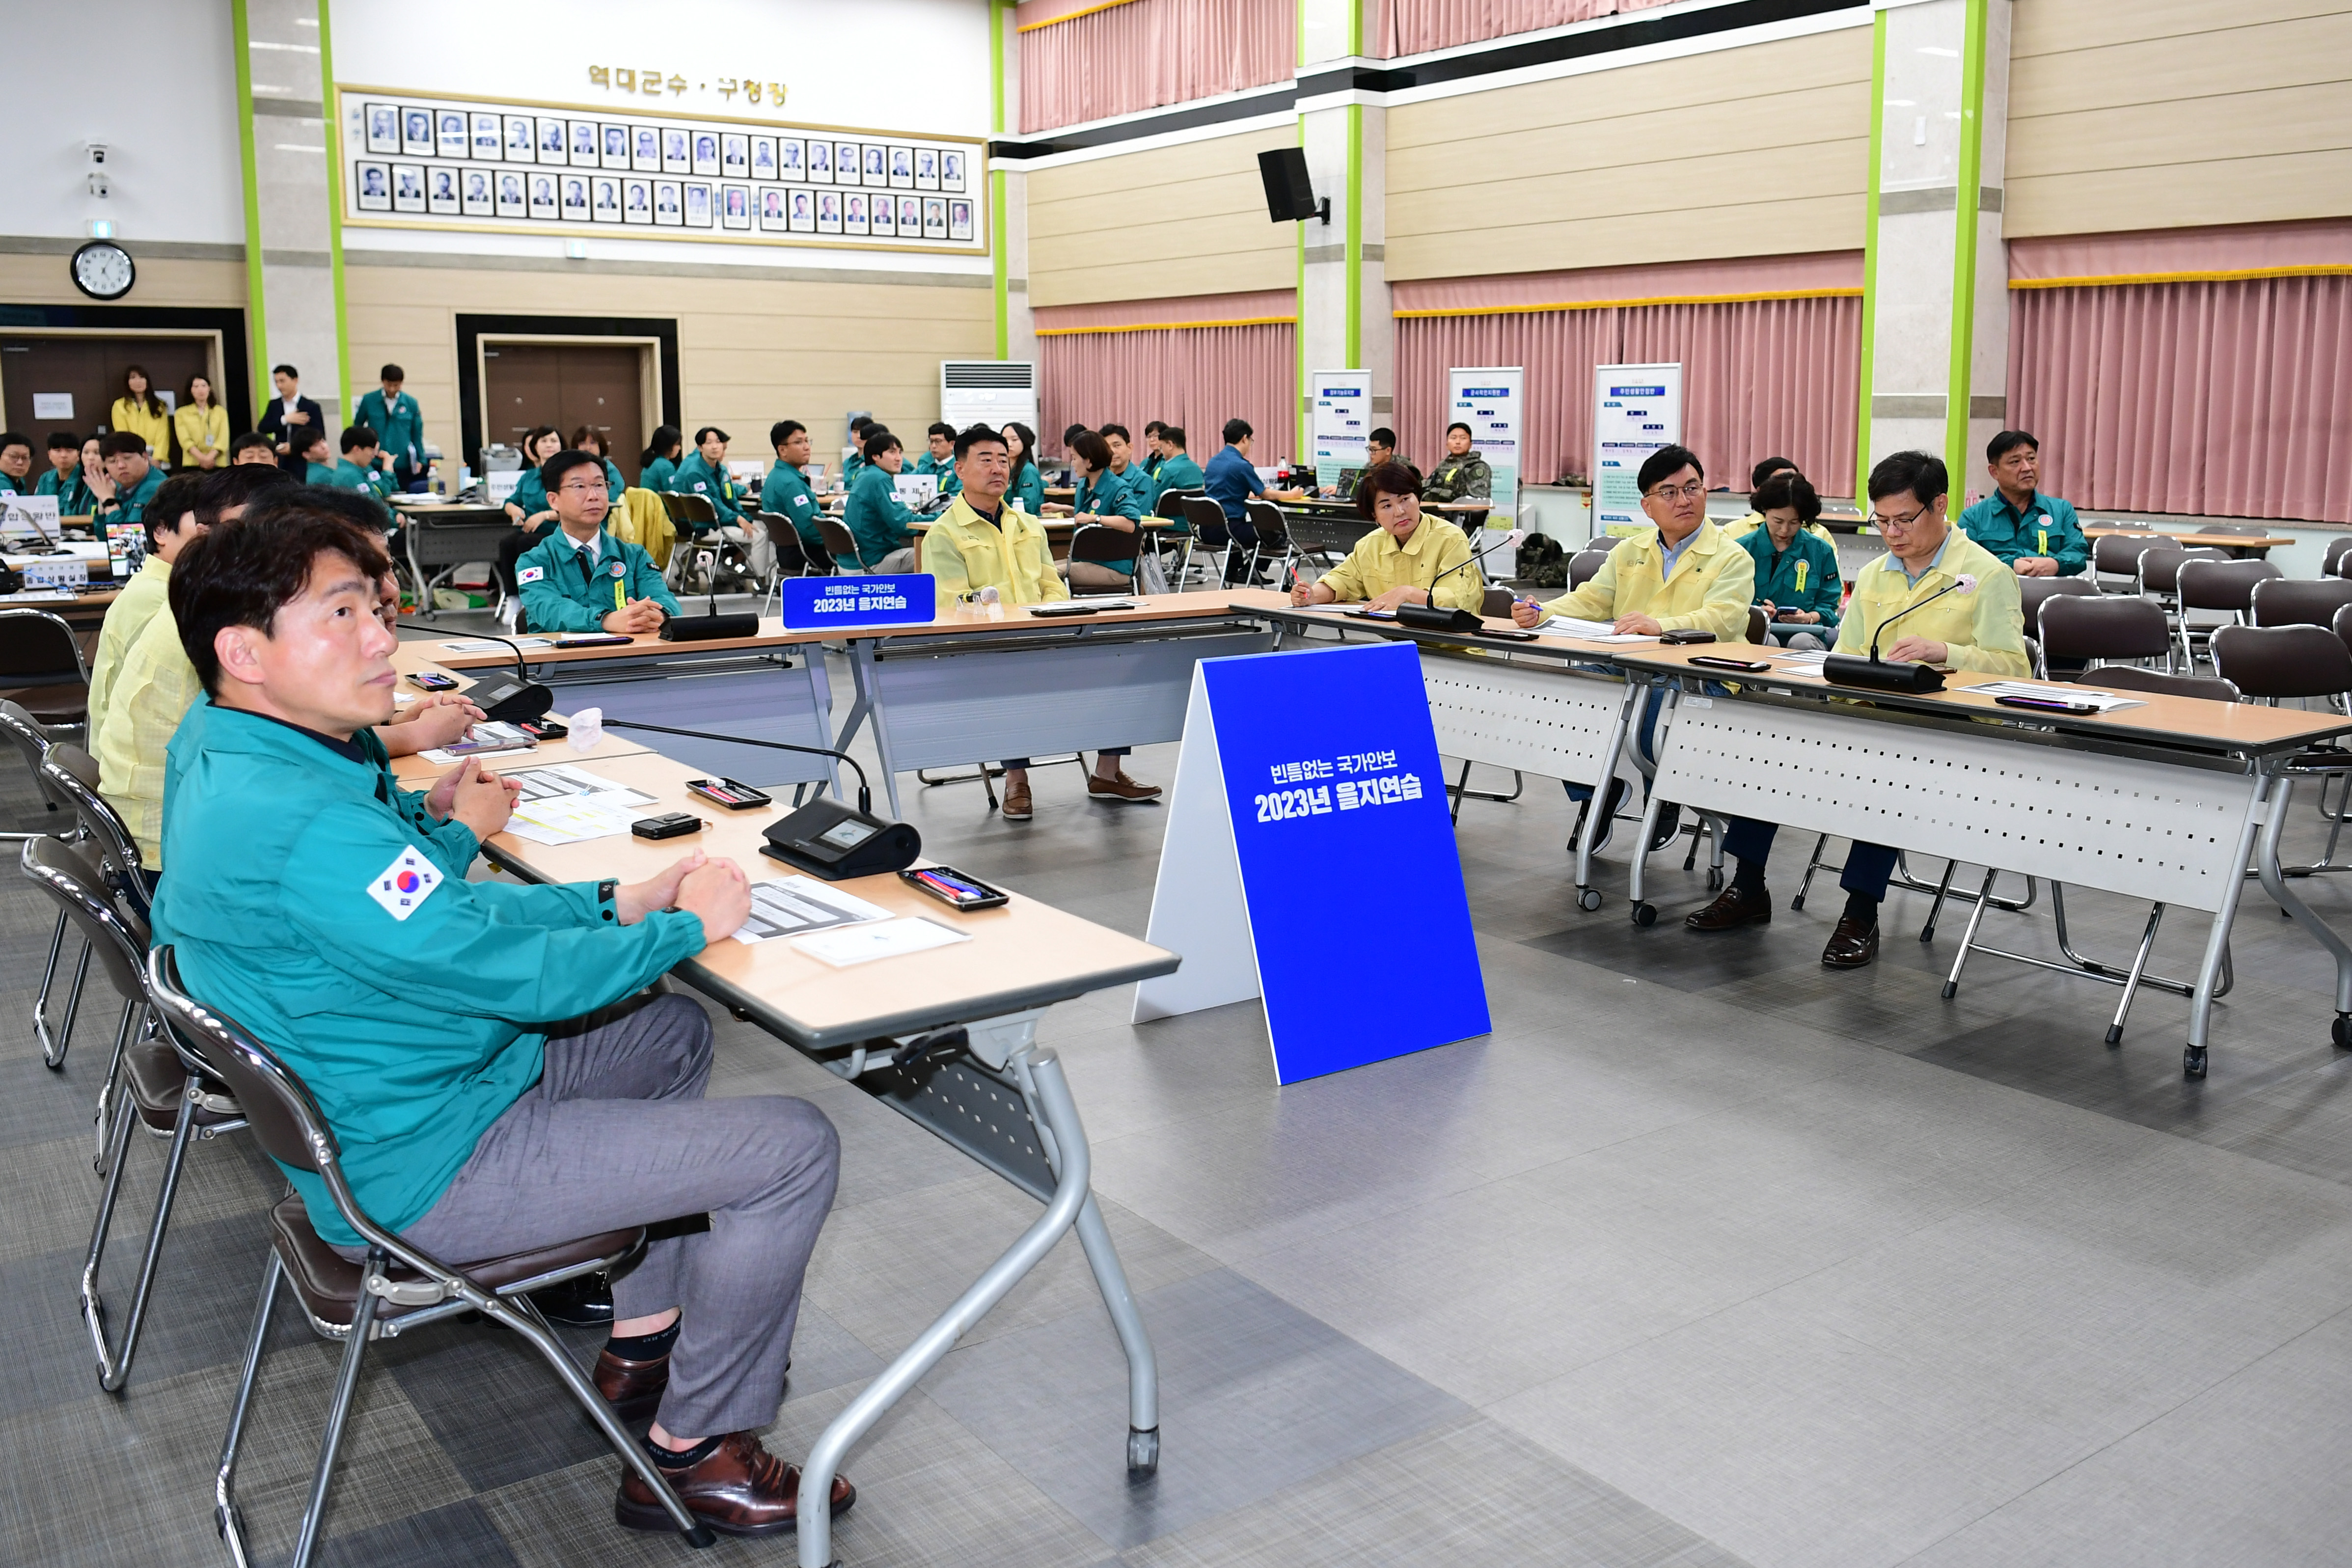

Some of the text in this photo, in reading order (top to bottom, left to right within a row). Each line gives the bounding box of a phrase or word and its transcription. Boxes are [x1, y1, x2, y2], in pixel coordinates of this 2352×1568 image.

[825, 584, 896, 596] 빈틈없는 국가안보
[814, 596, 907, 613] 2023년 을지연습
[1270, 749, 1398, 785] 빈틈없는 국가안보
[1255, 773, 1423, 823] 2023년 을지연습
